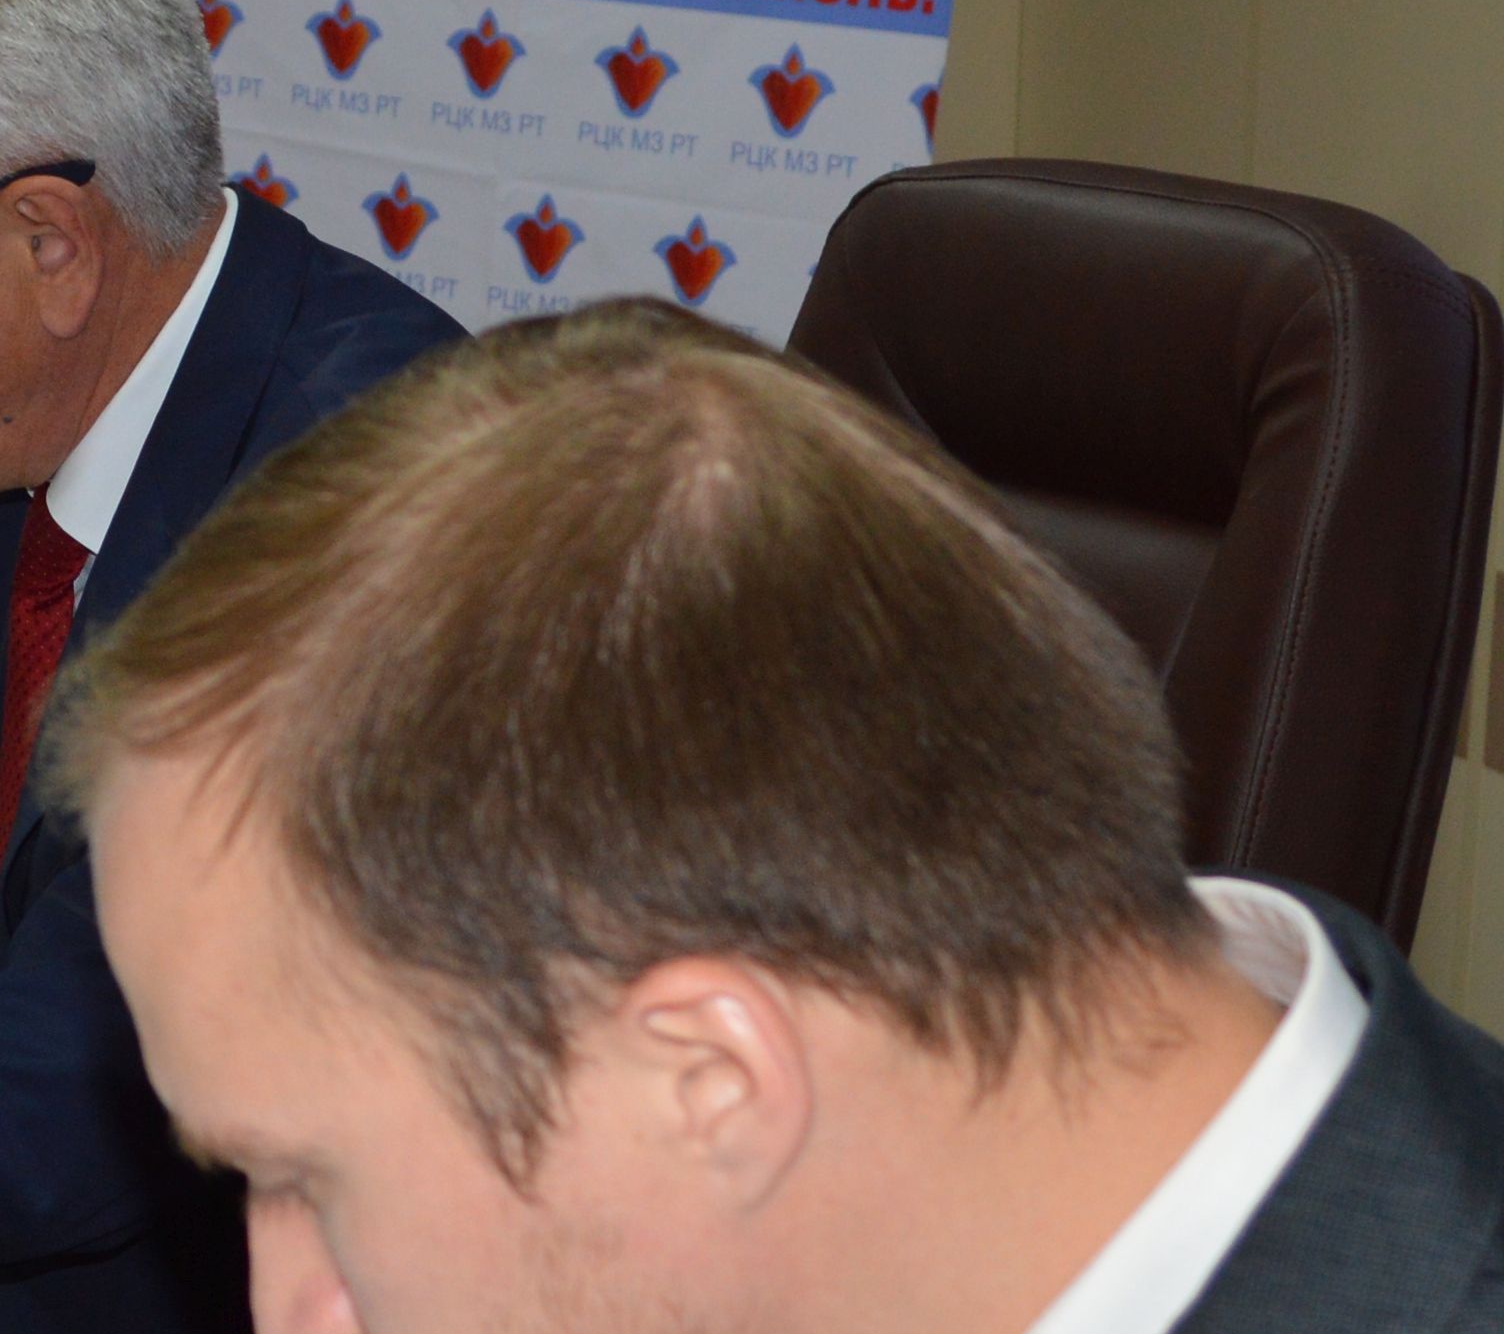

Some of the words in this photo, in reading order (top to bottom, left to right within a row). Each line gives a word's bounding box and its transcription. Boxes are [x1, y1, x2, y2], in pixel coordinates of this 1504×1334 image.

[239, 76, 264, 99] РТ
[292, 82, 334, 112] РЦК
[340, 90, 370, 114] МЗ
[376, 94, 403, 118] РТ
[432, 101, 476, 132] РЦК
[482, 109, 512, 135] МЗ
[519, 112, 548, 137] РТ
[578, 120, 625, 153] РЦК
[631, 131, 664, 155] МЗ
[671, 133, 699, 158] РТ
[731, 140, 778, 172] РЦК
[784, 150, 820, 175] МЗ
[826, 153, 859, 179] РТ
[432, 276, 459, 300] РТ
[487, 285, 533, 315] РЦК
